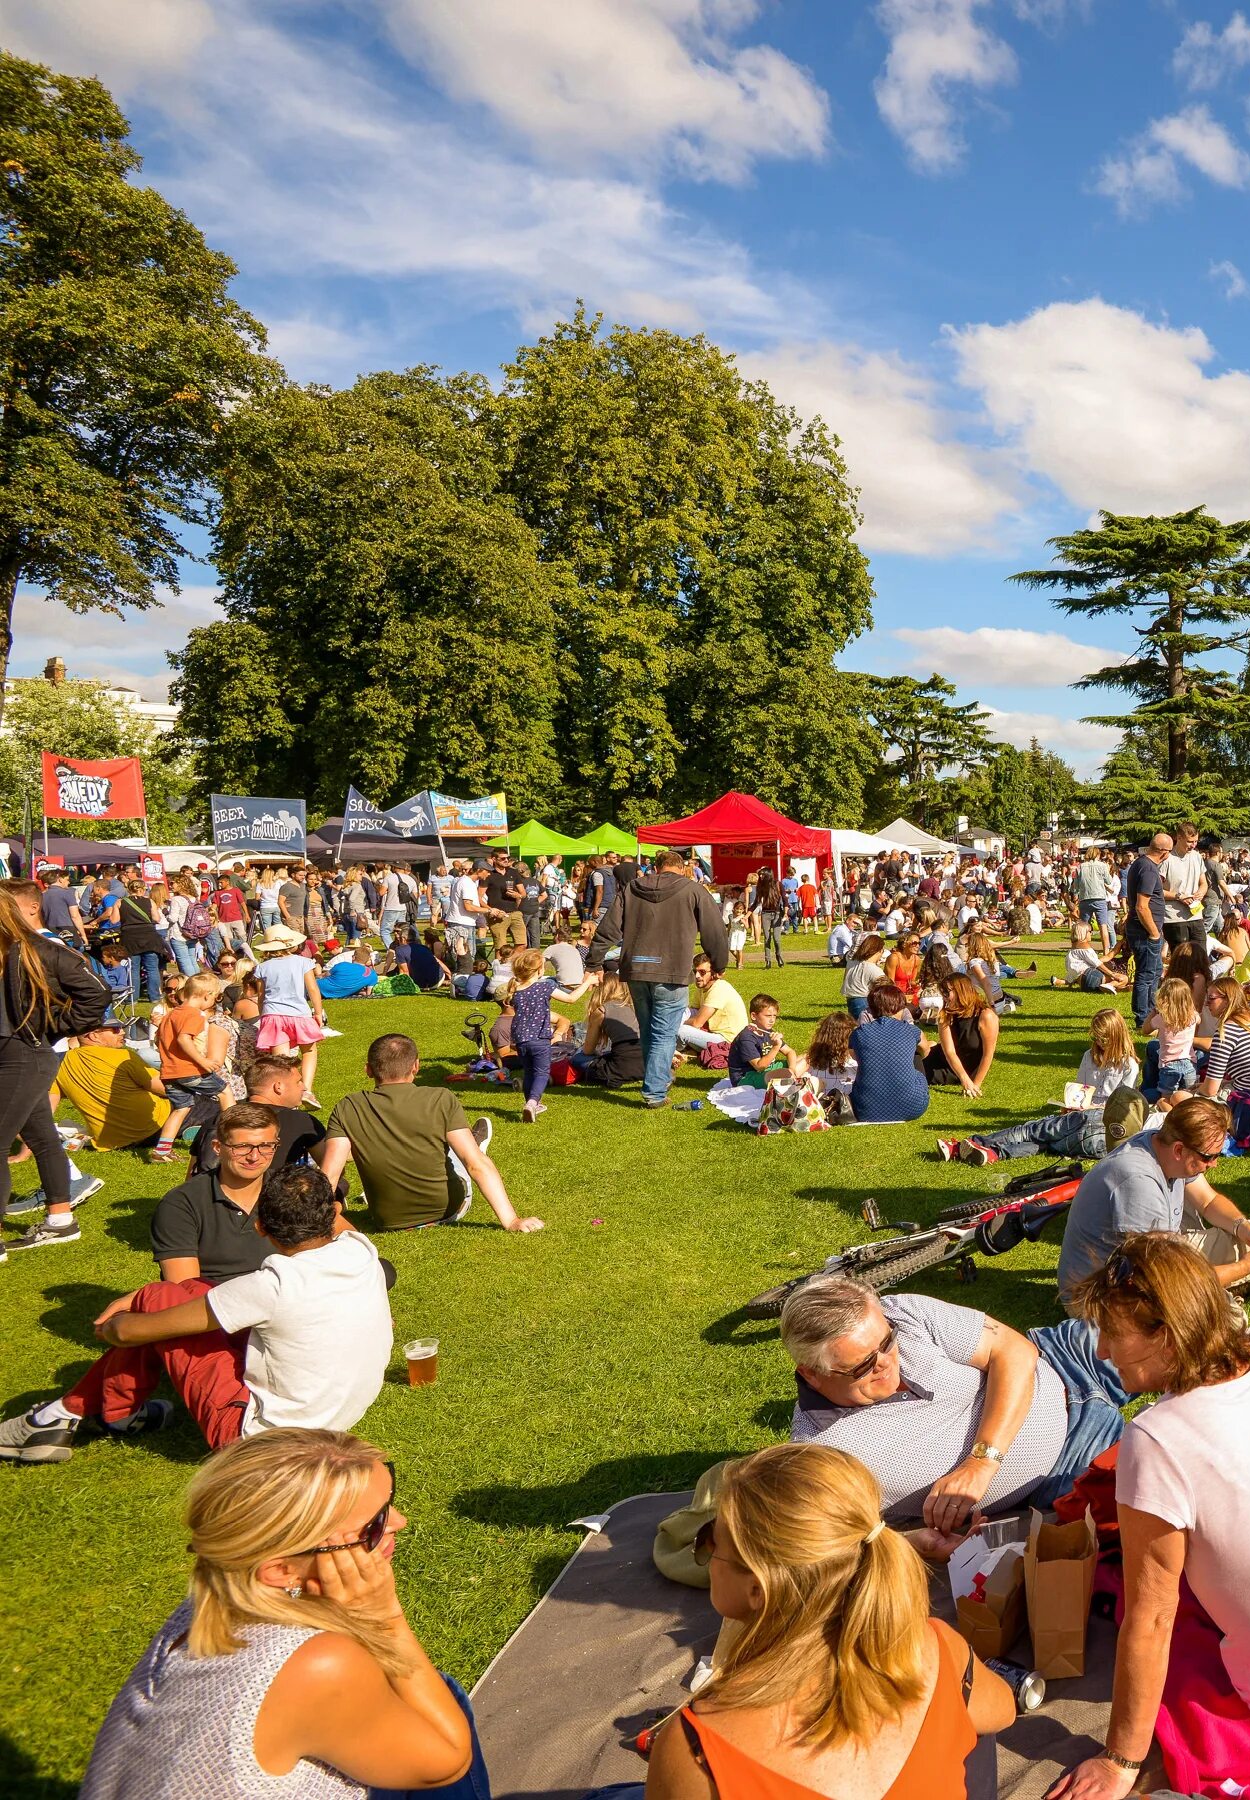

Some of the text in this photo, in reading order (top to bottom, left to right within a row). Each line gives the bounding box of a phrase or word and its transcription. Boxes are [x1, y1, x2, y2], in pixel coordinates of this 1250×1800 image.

[59, 799, 107, 814] FESTIVAL
[213, 807, 247, 824] BEER
[216, 825, 250, 844] FEST!
